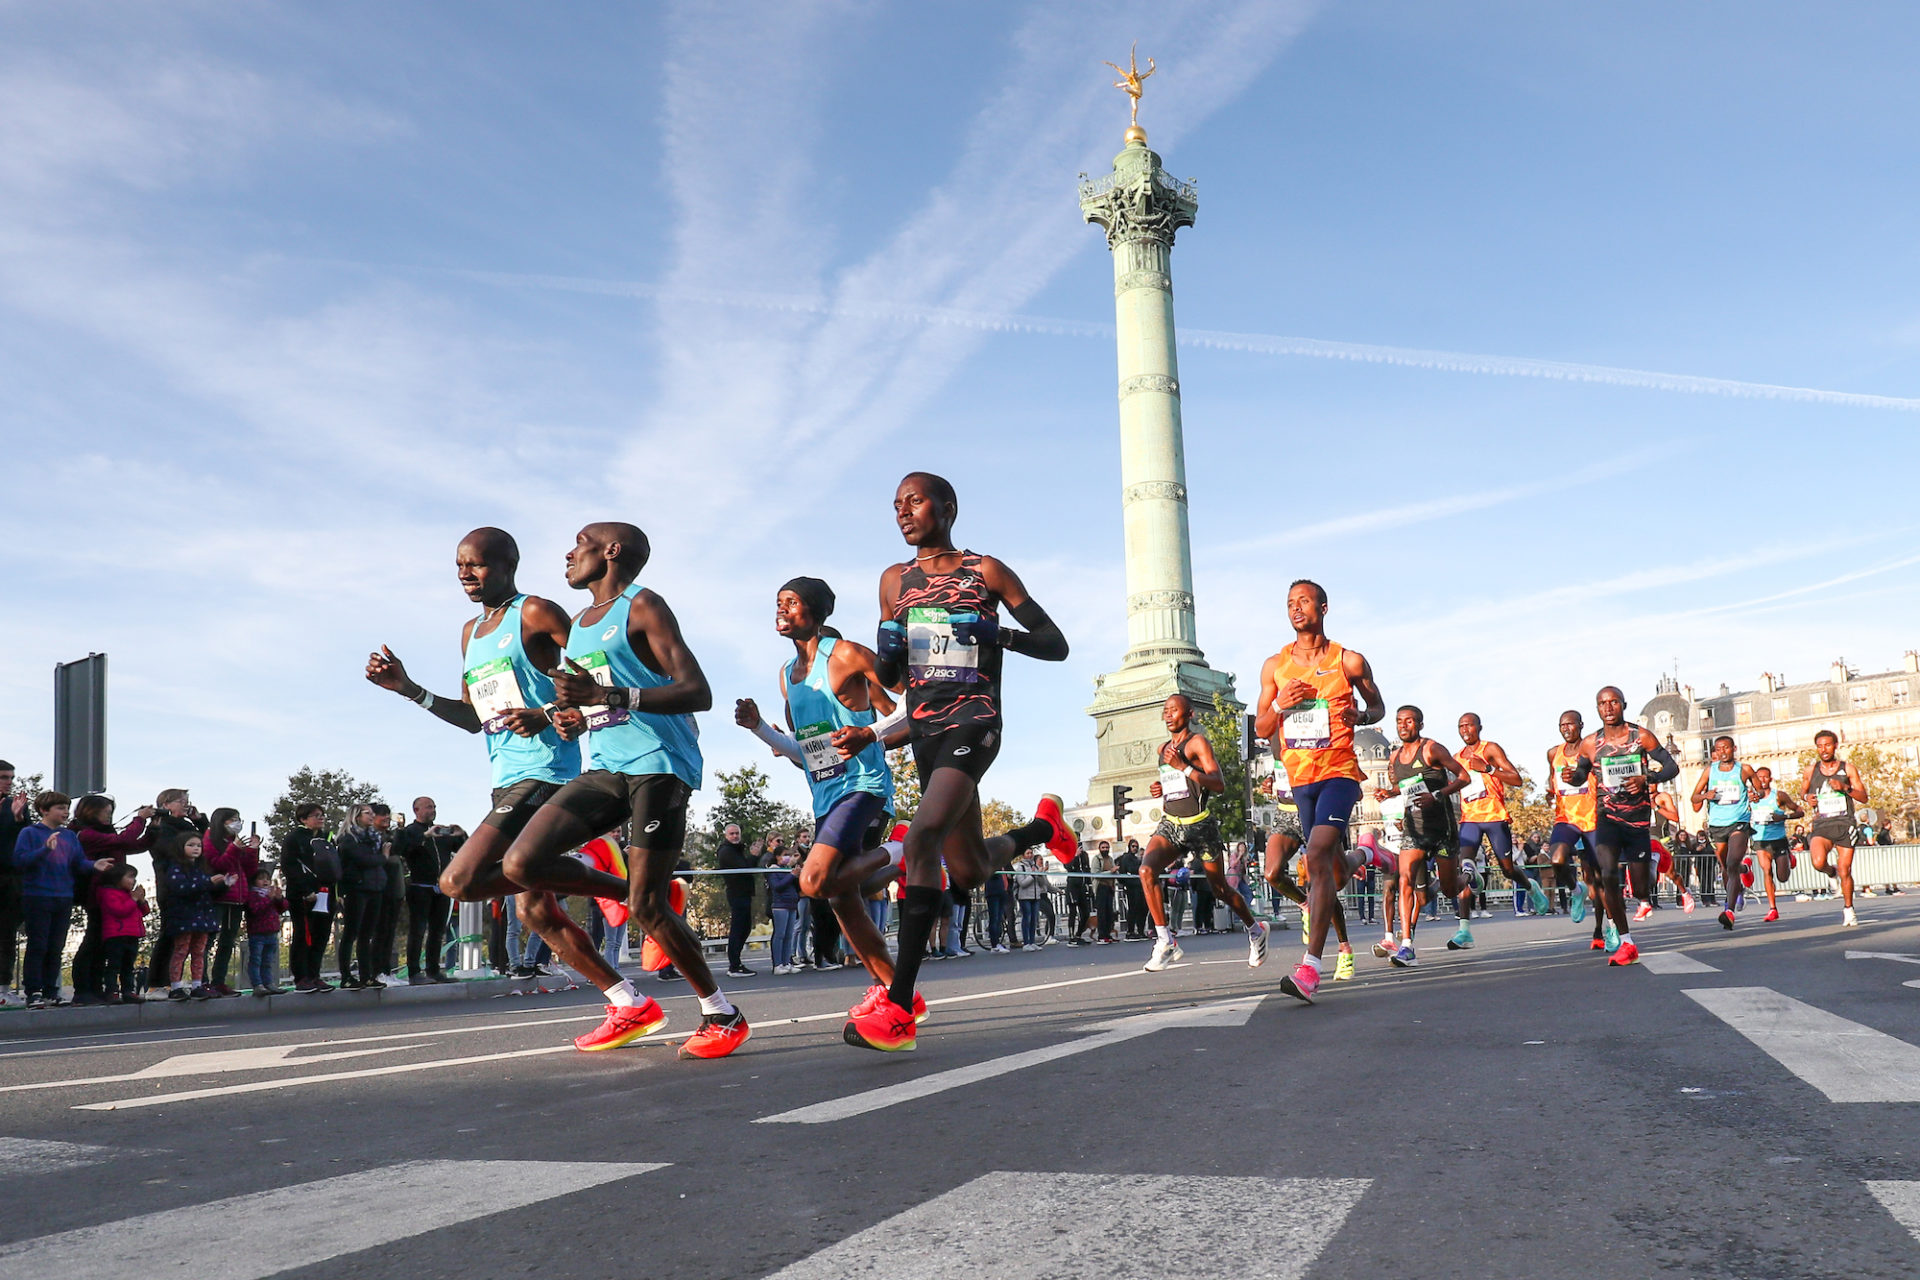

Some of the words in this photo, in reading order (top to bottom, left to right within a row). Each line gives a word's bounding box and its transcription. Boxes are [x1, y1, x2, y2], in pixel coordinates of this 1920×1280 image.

[932, 634, 950, 655] 37
[477, 680, 499, 700] KIROP
[830, 755, 839, 764] 30
[1608, 765, 1635, 776] KIMUTAI
